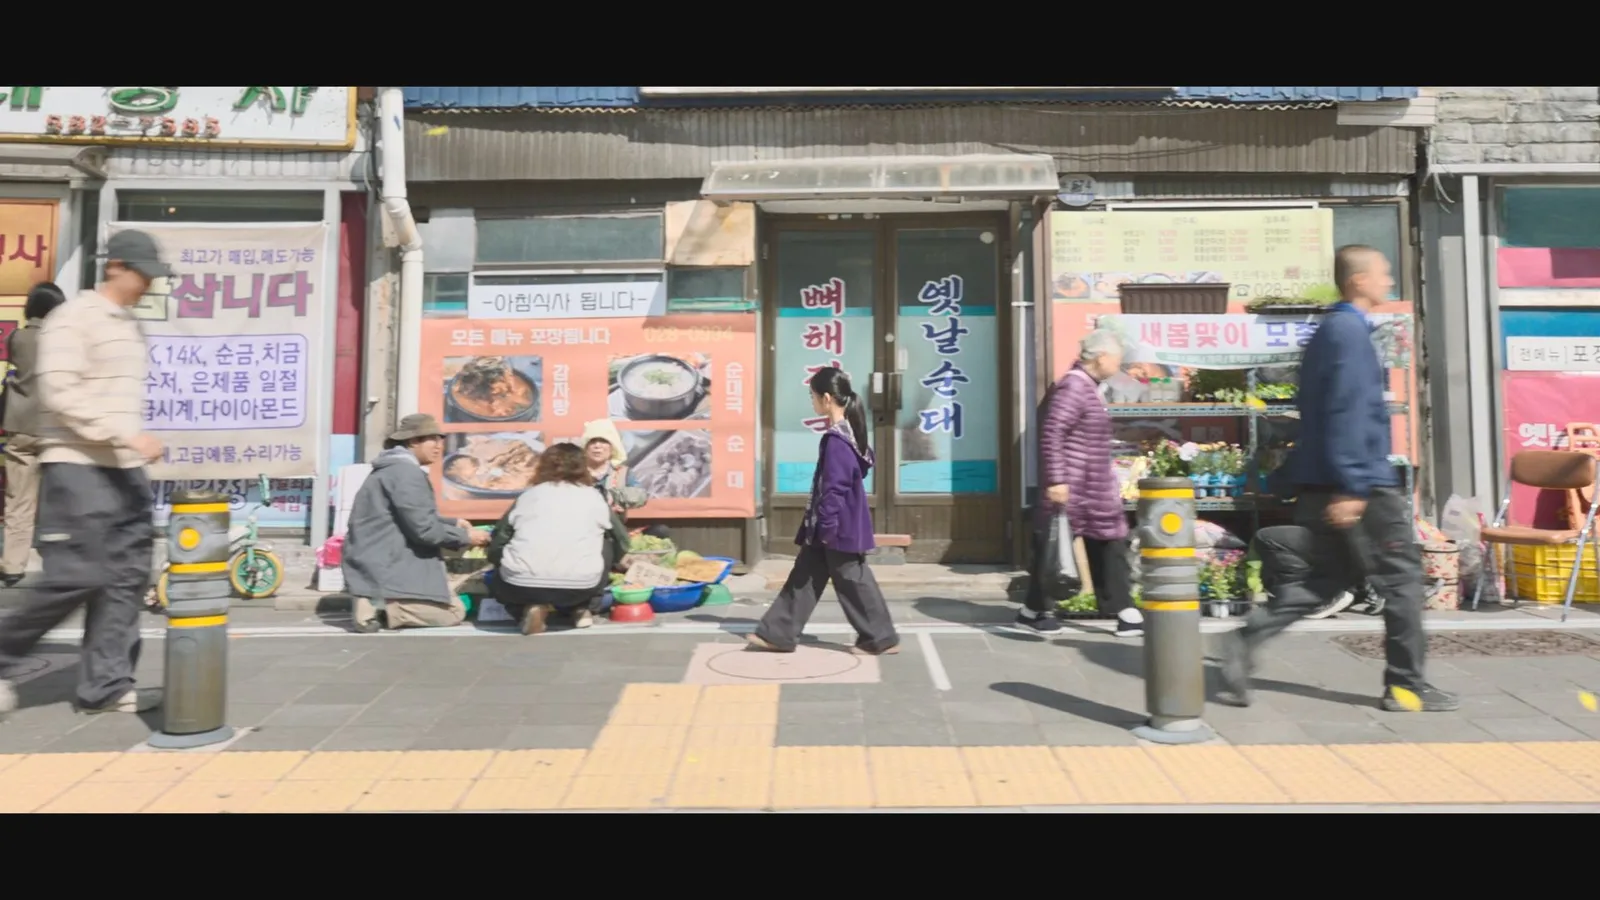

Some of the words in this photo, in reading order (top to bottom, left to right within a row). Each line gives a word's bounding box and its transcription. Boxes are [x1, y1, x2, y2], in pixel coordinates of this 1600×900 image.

[180, 249, 222, 264] 최고가
[450, 329, 485, 346] 모든
[491, 330, 524, 345] 메뉴
[530, 327, 611, 345] 포장됩니다
[1138, 321, 1248, 349] 새봄맞이
[918, 274, 969, 439] 옛날순대
[191, 370, 250, 394] 은제품
[259, 369, 298, 393] 일절
[553, 364, 569, 416] 감자탕
[725, 361, 744, 415] 순대국
